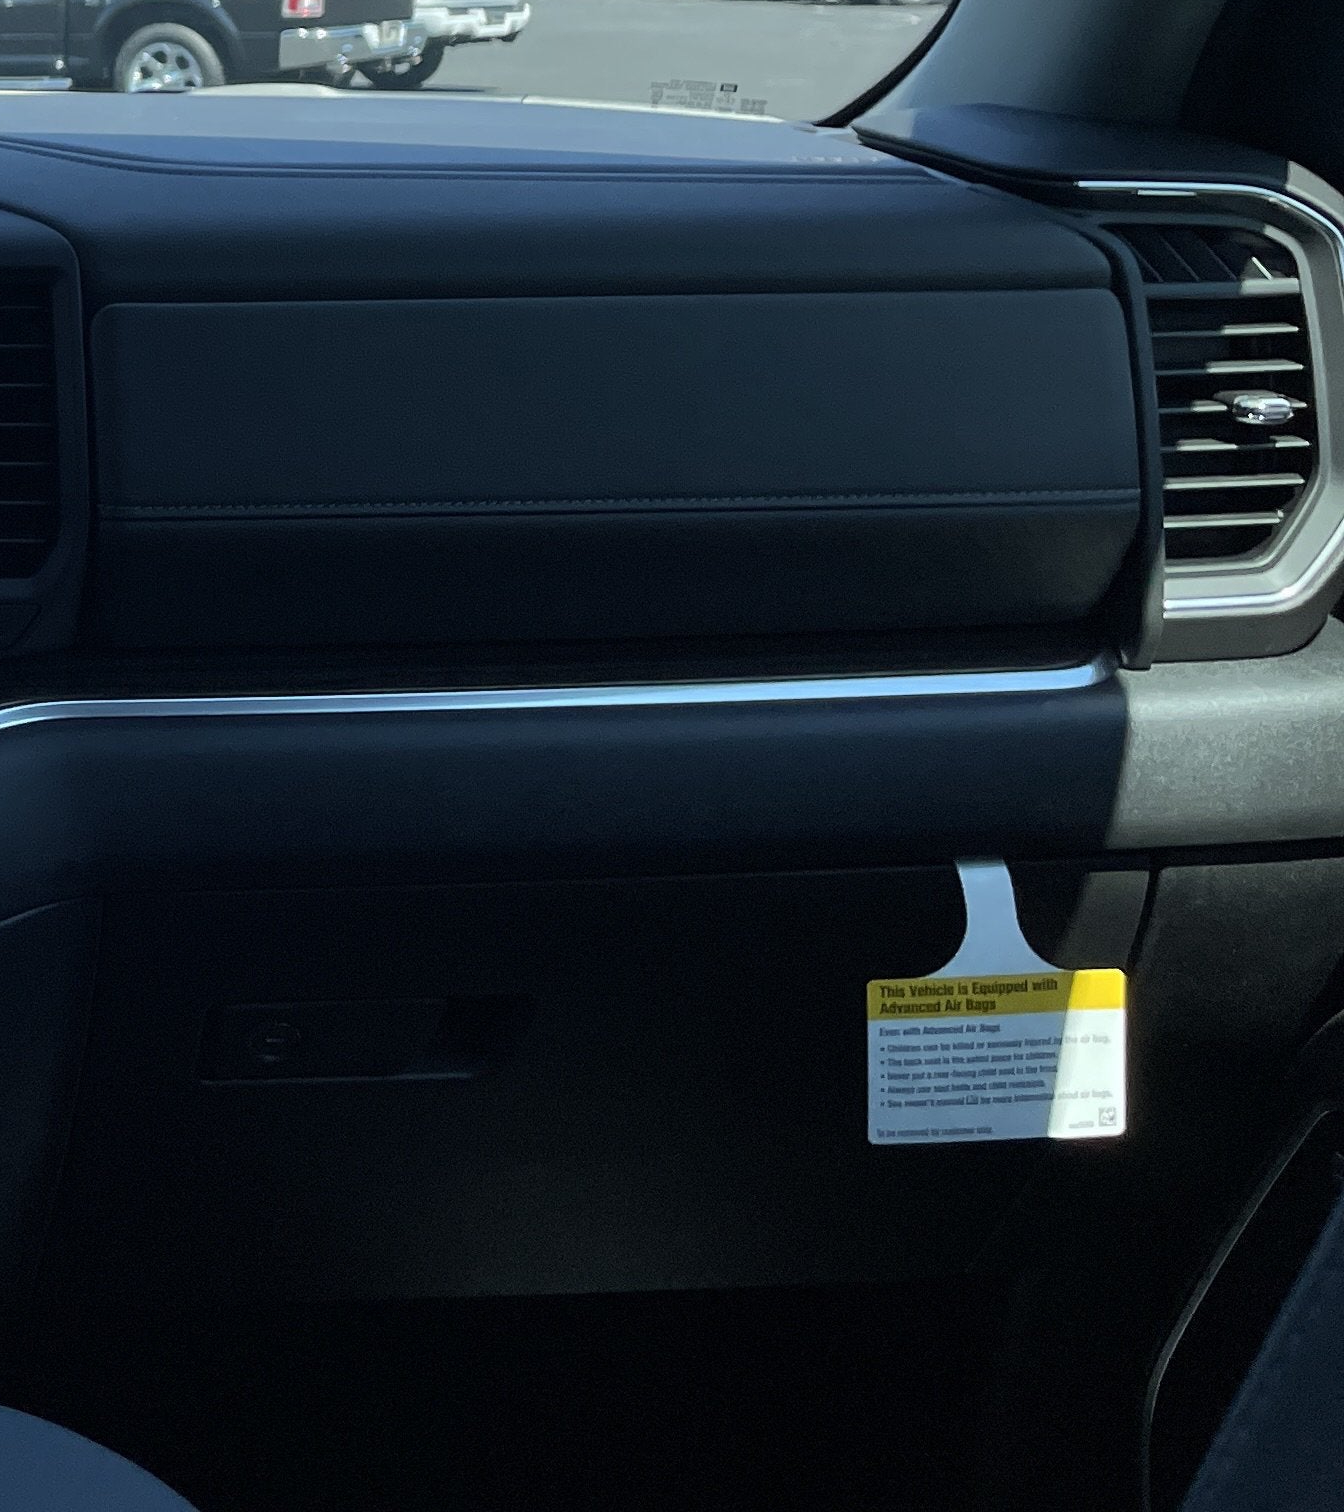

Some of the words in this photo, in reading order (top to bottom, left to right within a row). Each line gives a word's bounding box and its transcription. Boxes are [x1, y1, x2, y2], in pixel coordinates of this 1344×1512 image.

[879, 985, 905, 999] This
[908, 983, 954, 997] Vehicle
[957, 982, 968, 996] is
[971, 979, 1028, 996] Equipped
[1032, 978, 1058, 991] with
[879, 1001, 941, 1015] Advanced
[945, 999, 961, 1013] Air
[965, 997, 997, 1013] Bags
